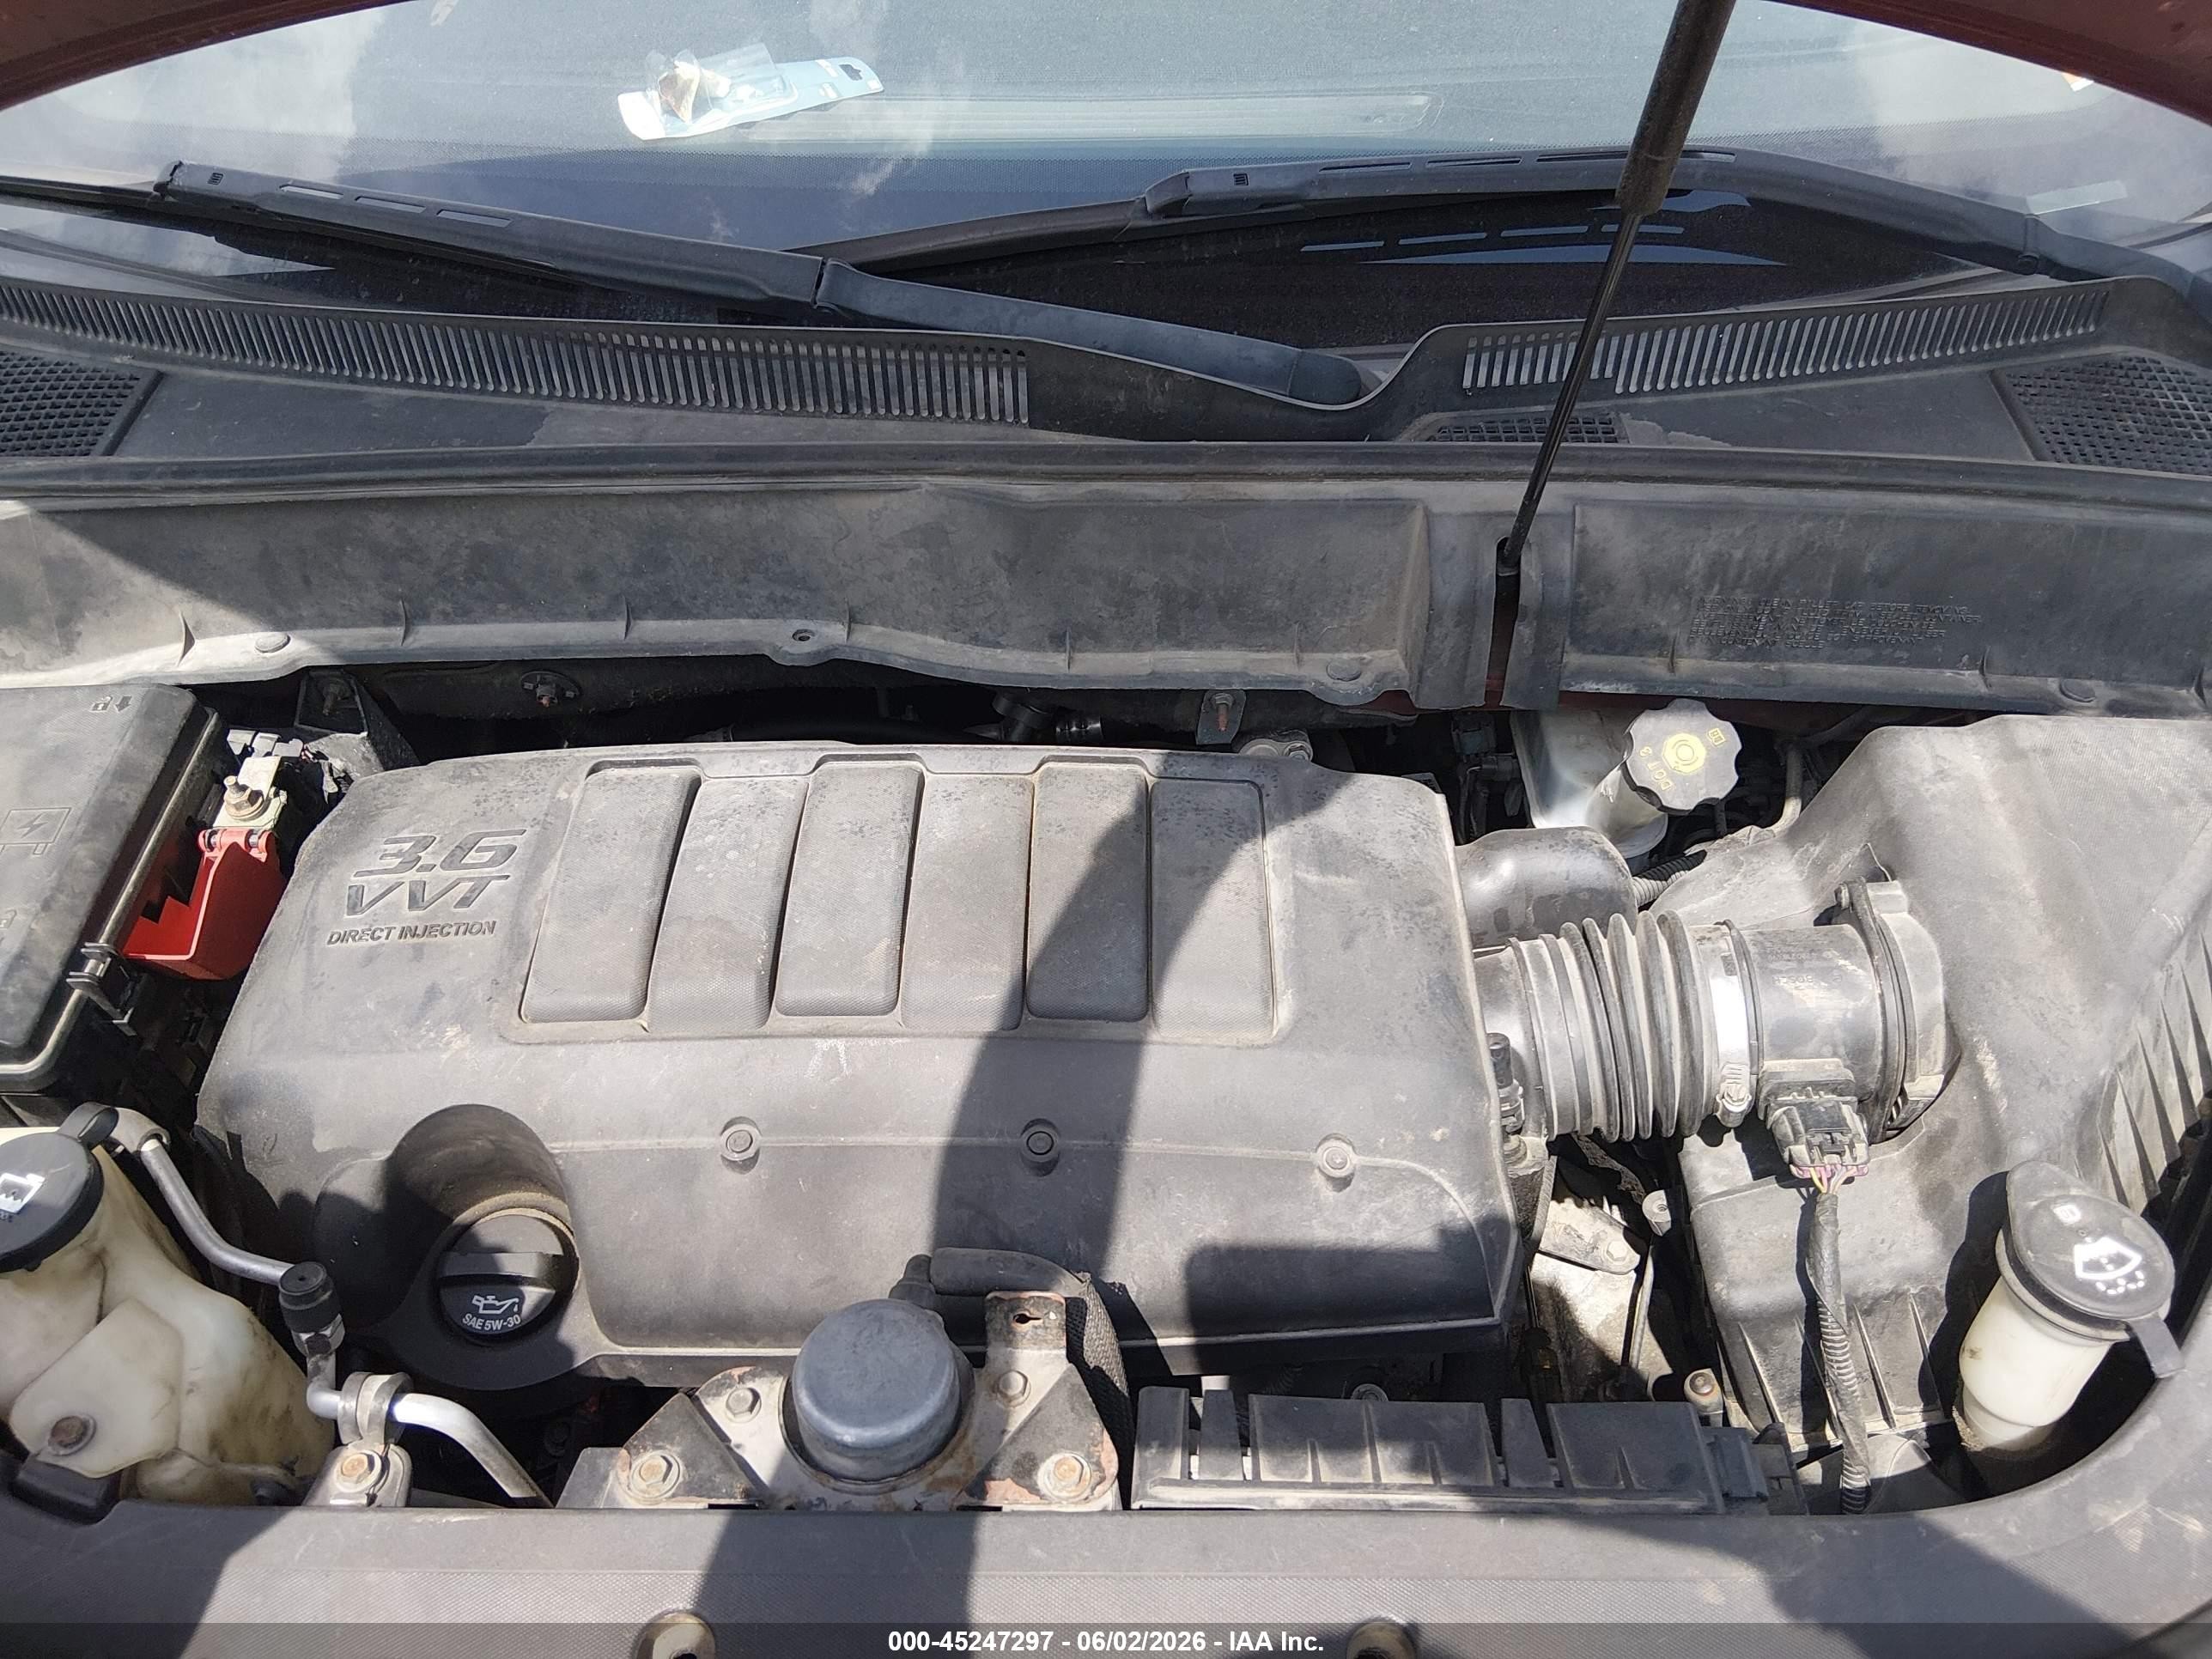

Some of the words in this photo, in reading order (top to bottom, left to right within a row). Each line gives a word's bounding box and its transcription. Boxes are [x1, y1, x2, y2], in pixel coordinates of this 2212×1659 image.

[1647, 762, 1674, 791] DOT
[352, 829, 527, 878] 3.6
[346, 874, 511, 916] VVT
[327, 926, 397, 945] DIRECT
[398, 920, 497, 940] INJECTION
[462, 1313, 484, 1330] SAE
[483, 1314, 521, 1331] 5W-30
